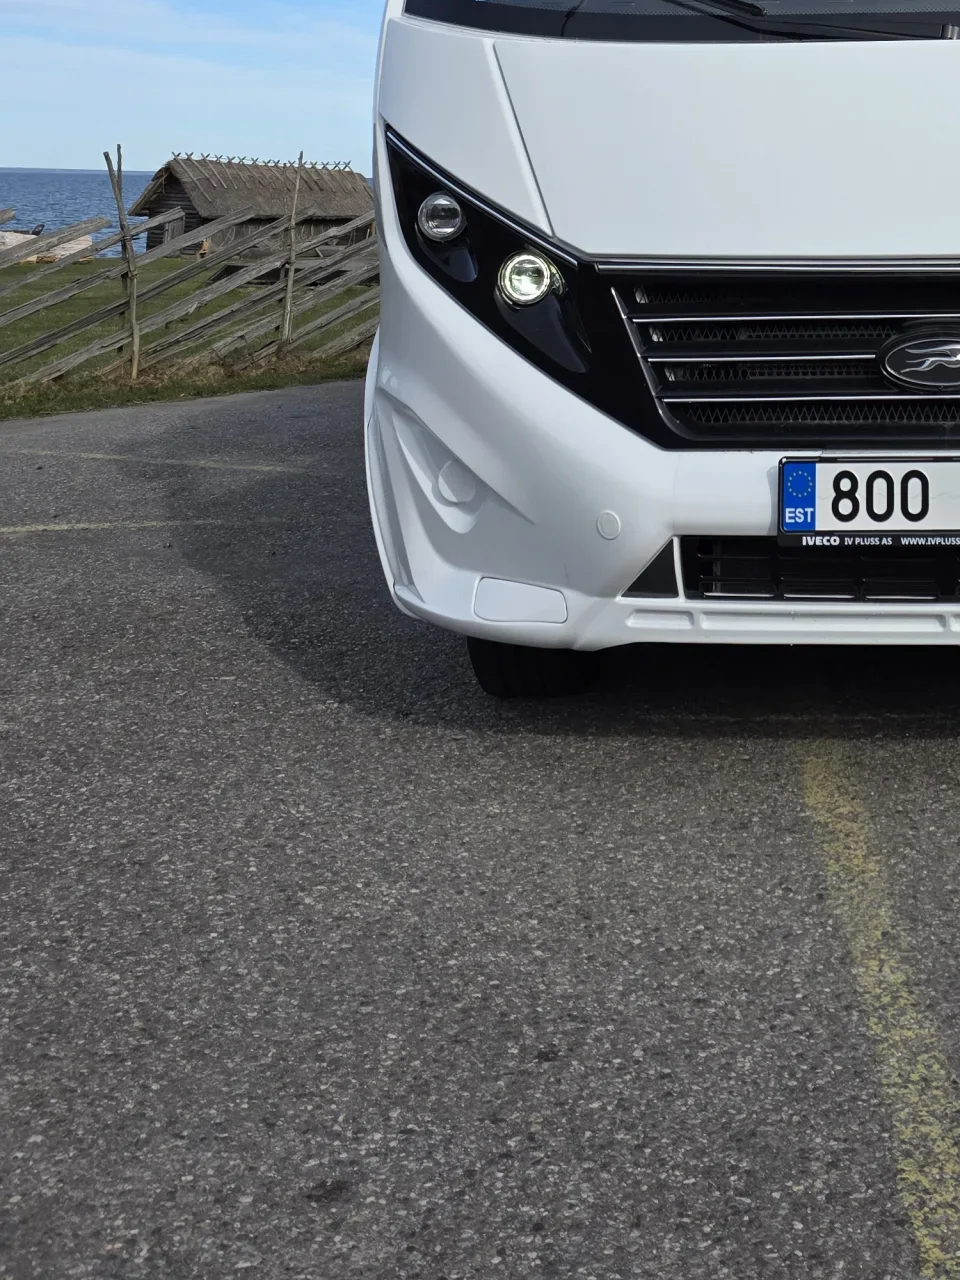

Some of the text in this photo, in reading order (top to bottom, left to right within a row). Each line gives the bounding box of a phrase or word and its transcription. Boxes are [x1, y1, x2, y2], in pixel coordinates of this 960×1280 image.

[831, 470, 930, 522] 800
[785, 507, 814, 523] EST
[802, 536, 840, 546] IVECO
[844, 537, 853, 546] IV
[855, 537, 880, 546] PLUSS
[881, 537, 893, 546] AS
